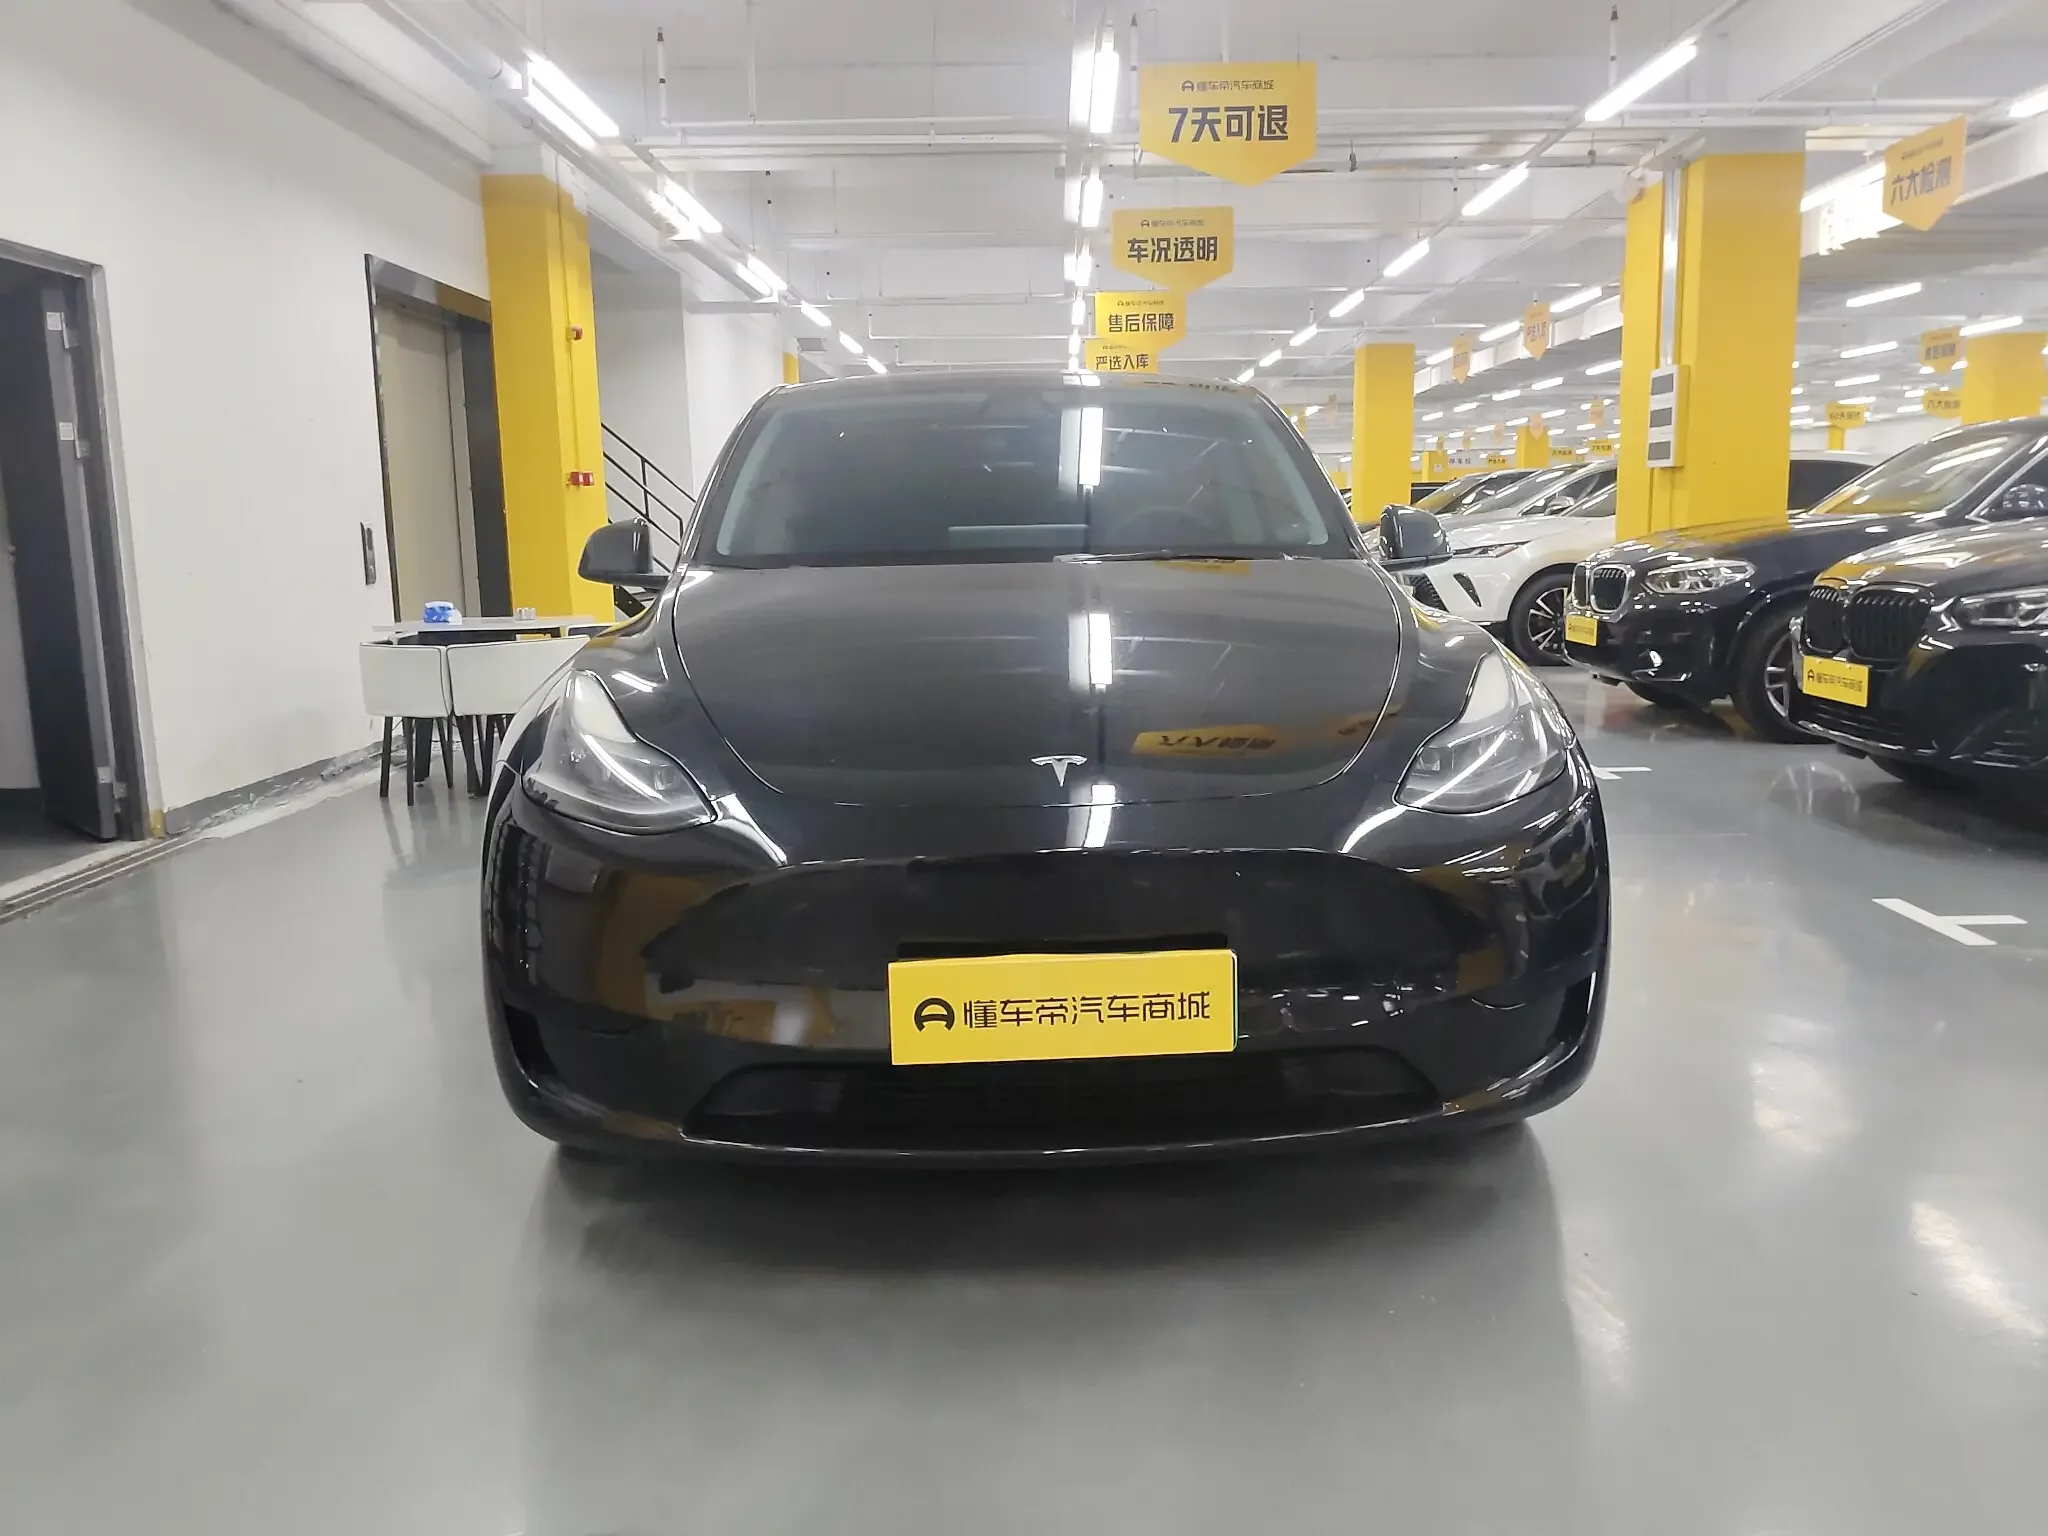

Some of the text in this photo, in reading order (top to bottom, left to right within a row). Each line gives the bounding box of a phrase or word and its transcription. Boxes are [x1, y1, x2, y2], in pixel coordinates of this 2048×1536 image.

[1168, 105, 1288, 142] 7天可退
[1127, 236, 1218, 263] 车况透明
[1108, 312, 1174, 333] 售后保障
[1095, 353, 1149, 371] 严选入库
[963, 991, 1210, 1029] 懂车帝汽车商城
